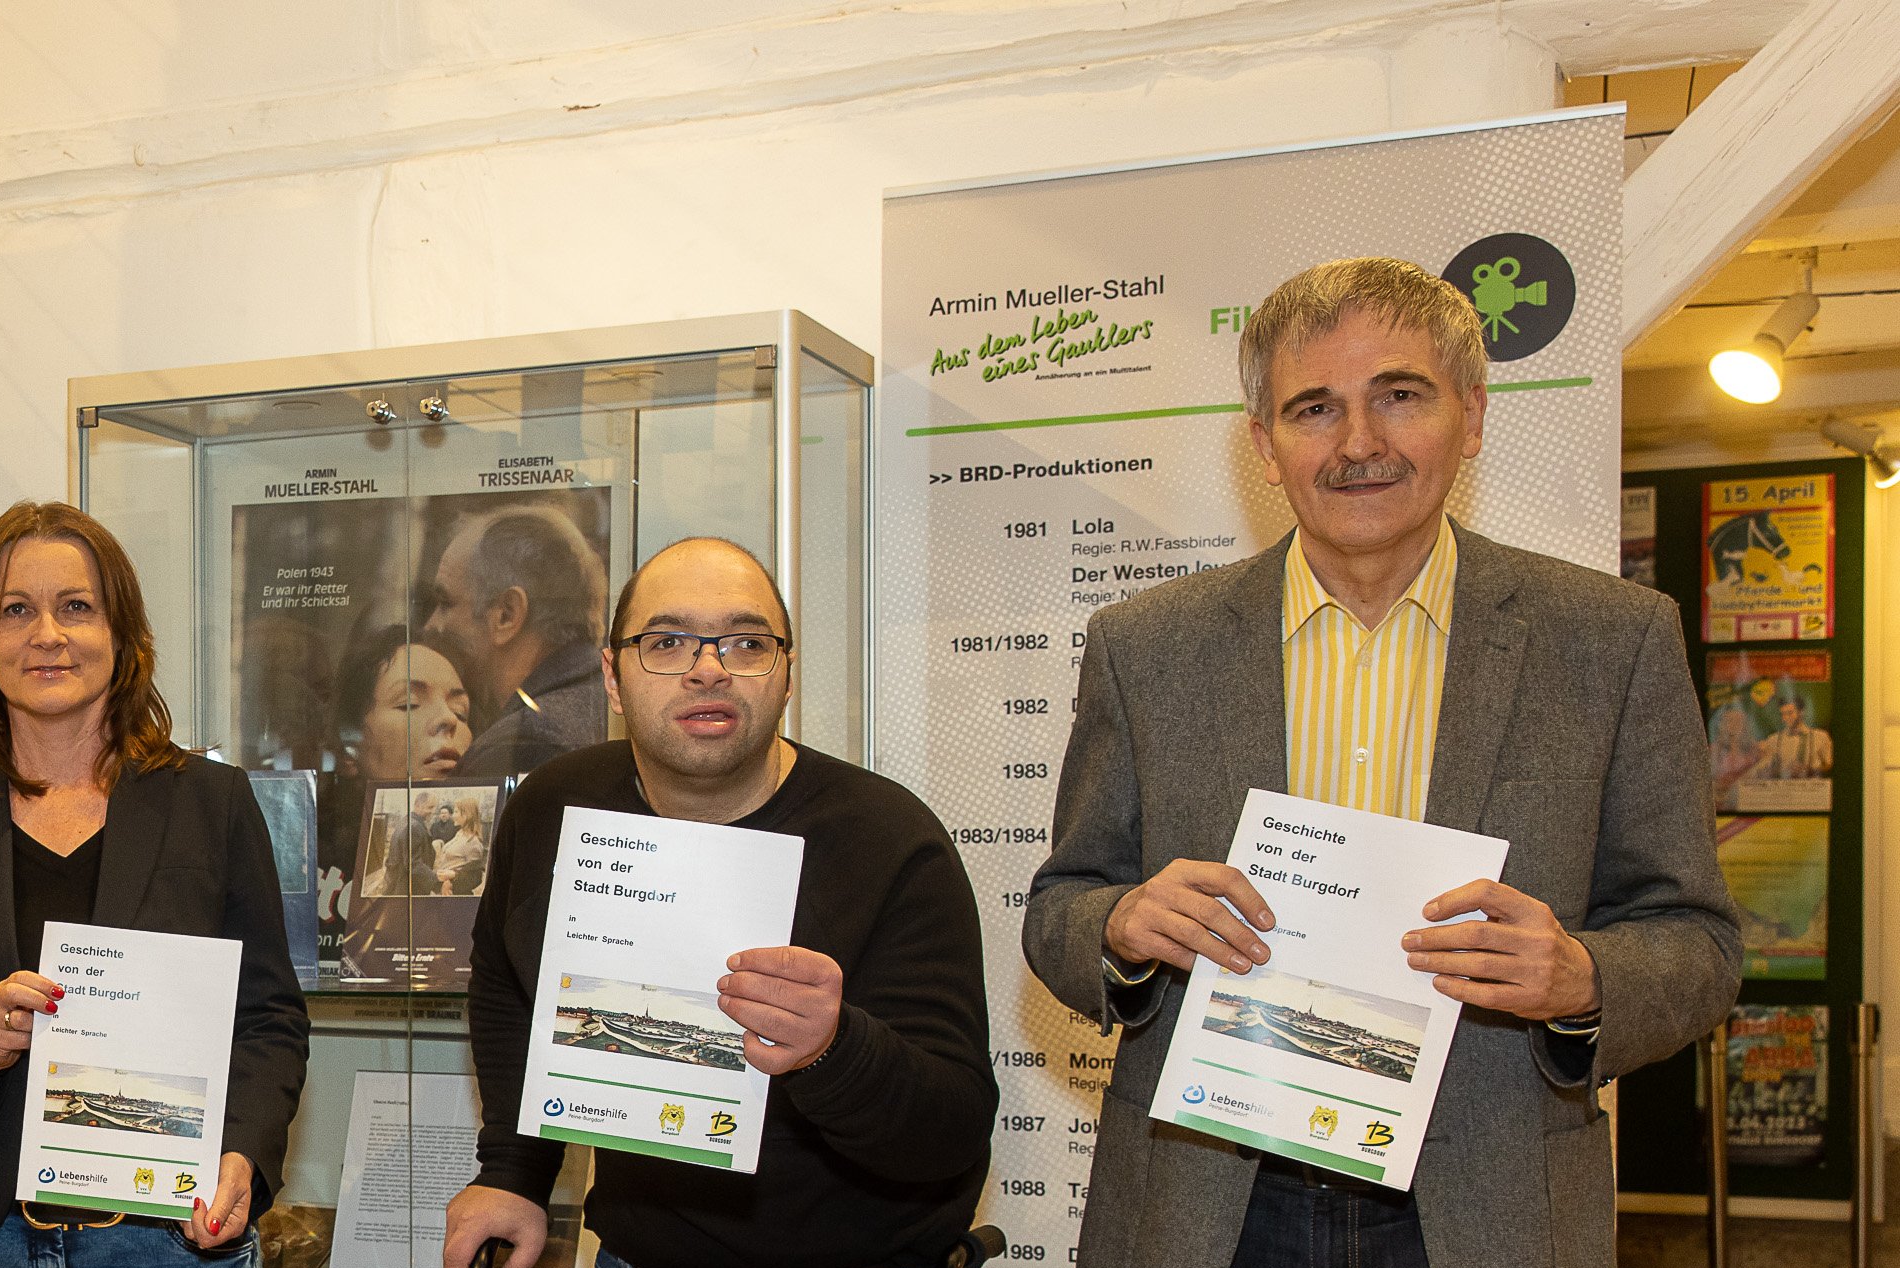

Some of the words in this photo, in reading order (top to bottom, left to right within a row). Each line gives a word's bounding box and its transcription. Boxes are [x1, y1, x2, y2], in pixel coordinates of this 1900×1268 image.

[929, 293, 996, 316] Armin
[1006, 275, 1164, 309] Mueller-Stahl
[930, 348, 970, 376] Aus
[977, 331, 1026, 360] dem
[1031, 308, 1098, 343] Leben
[982, 350, 1040, 382] eines
[1048, 320, 1153, 367] Gauklers
[498, 456, 554, 468] ELISABETH
[959, 457, 1153, 483] BRD-Produktionen
[305, 468, 337, 479] ARMIN
[479, 469, 574, 487] TRISSENAAR
[264, 479, 378, 498] MUELLER-STAHL
[1723, 484, 1748, 503] 15
[1763, 480, 1815, 504] April
[1004, 521, 1047, 539] 1981
[1072, 518, 1114, 535] Lola
[1071, 542, 1116, 557] Regie:
[1121, 534, 1236, 552] R.W.Fassbinder
[277, 566, 307, 579] Polen
[310, 565, 334, 578] 1943
[1072, 567, 1108, 583] Der
[1113, 563, 1189, 581] Westen
[263, 585, 275, 596] Er
[276, 586, 295, 596] war
[297, 584, 312, 595] ihr
[314, 583, 348, 594] Retter
[261, 597, 282, 609] und
[285, 596, 299, 607] ihr
[301, 595, 350, 607] Schicksal
[1071, 591, 1116, 606] Regie:
[950, 634, 1048, 652] 1981/1982
[1003, 699, 1048, 715] 1982
[1003, 763, 1048, 779] 1983
[950, 828, 1047, 845] 1983/1984
[1262, 815, 1347, 846] Geschichte
[580, 832, 658, 853] Geschichte
[1255, 841, 1284, 857] von
[1291, 847, 1317, 865] der
[577, 857, 603, 871] von
[610, 861, 634, 874] der
[1248, 863, 1288, 885] Stadt
[1291, 873, 1361, 901] Burgdorf
[573, 879, 610, 896] Stadt
[613, 884, 677, 904] Burgdorf
[568, 914, 577, 922] in
[566, 931, 599, 943] Leichter
[602, 935, 634, 948] Sprache
[1272, 925, 1307, 940] Sprache
[60, 943, 125, 960] Geschichte
[58, 964, 79, 975] von
[85, 966, 105, 977] der
[57, 983, 86, 995] tadt
[89, 986, 141, 1001] Burgdorf
[51, 1026, 78, 1035] Leichter
[80, 1029, 108, 1038] Sprache
[989, 1051, 1046, 1068] /1986
[1069, 1076, 1109, 1093] Regie
[569, 1102, 628, 1121] Lebenshilfe
[1001, 1115, 1046, 1132] 1987
[59, 1170, 108, 1184] Lebenshilfe
[1000, 1180, 1046, 1197] 1988
[1002, 1245, 1045, 1261] 1989
